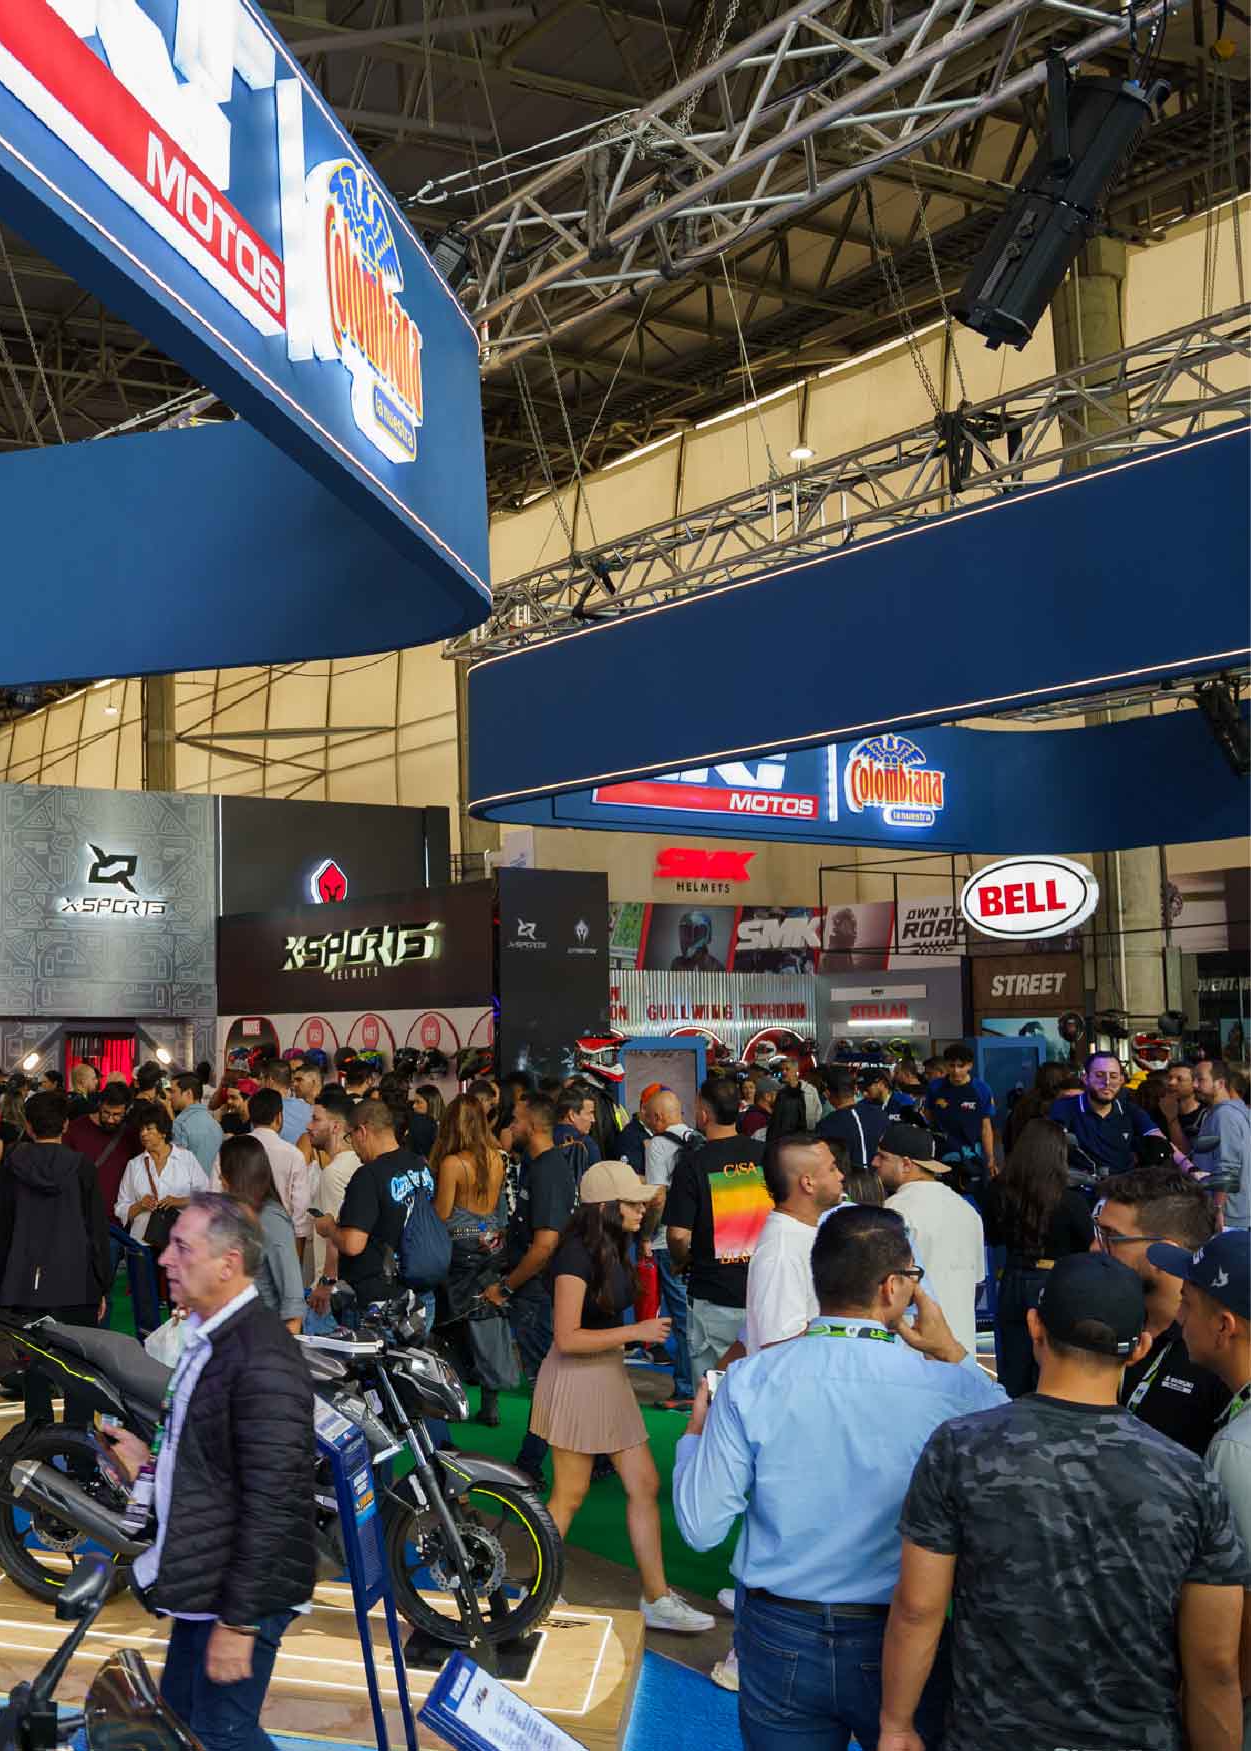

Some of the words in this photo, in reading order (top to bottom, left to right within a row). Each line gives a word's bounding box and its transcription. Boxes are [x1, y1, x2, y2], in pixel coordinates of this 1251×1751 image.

[146, 129, 283, 313] MOTOS
[324, 200, 422, 425] Colombiana
[850, 756, 945, 810] Colombiana
[729, 793, 813, 815] MOTOS
[654, 847, 757, 883] SMK
[676, 882, 731, 894] HELMETS
[978, 879, 1067, 917] BELL
[735, 915, 823, 950] SMK
[991, 973, 1066, 997] STREET
[724, 1160, 757, 1178] CASA
